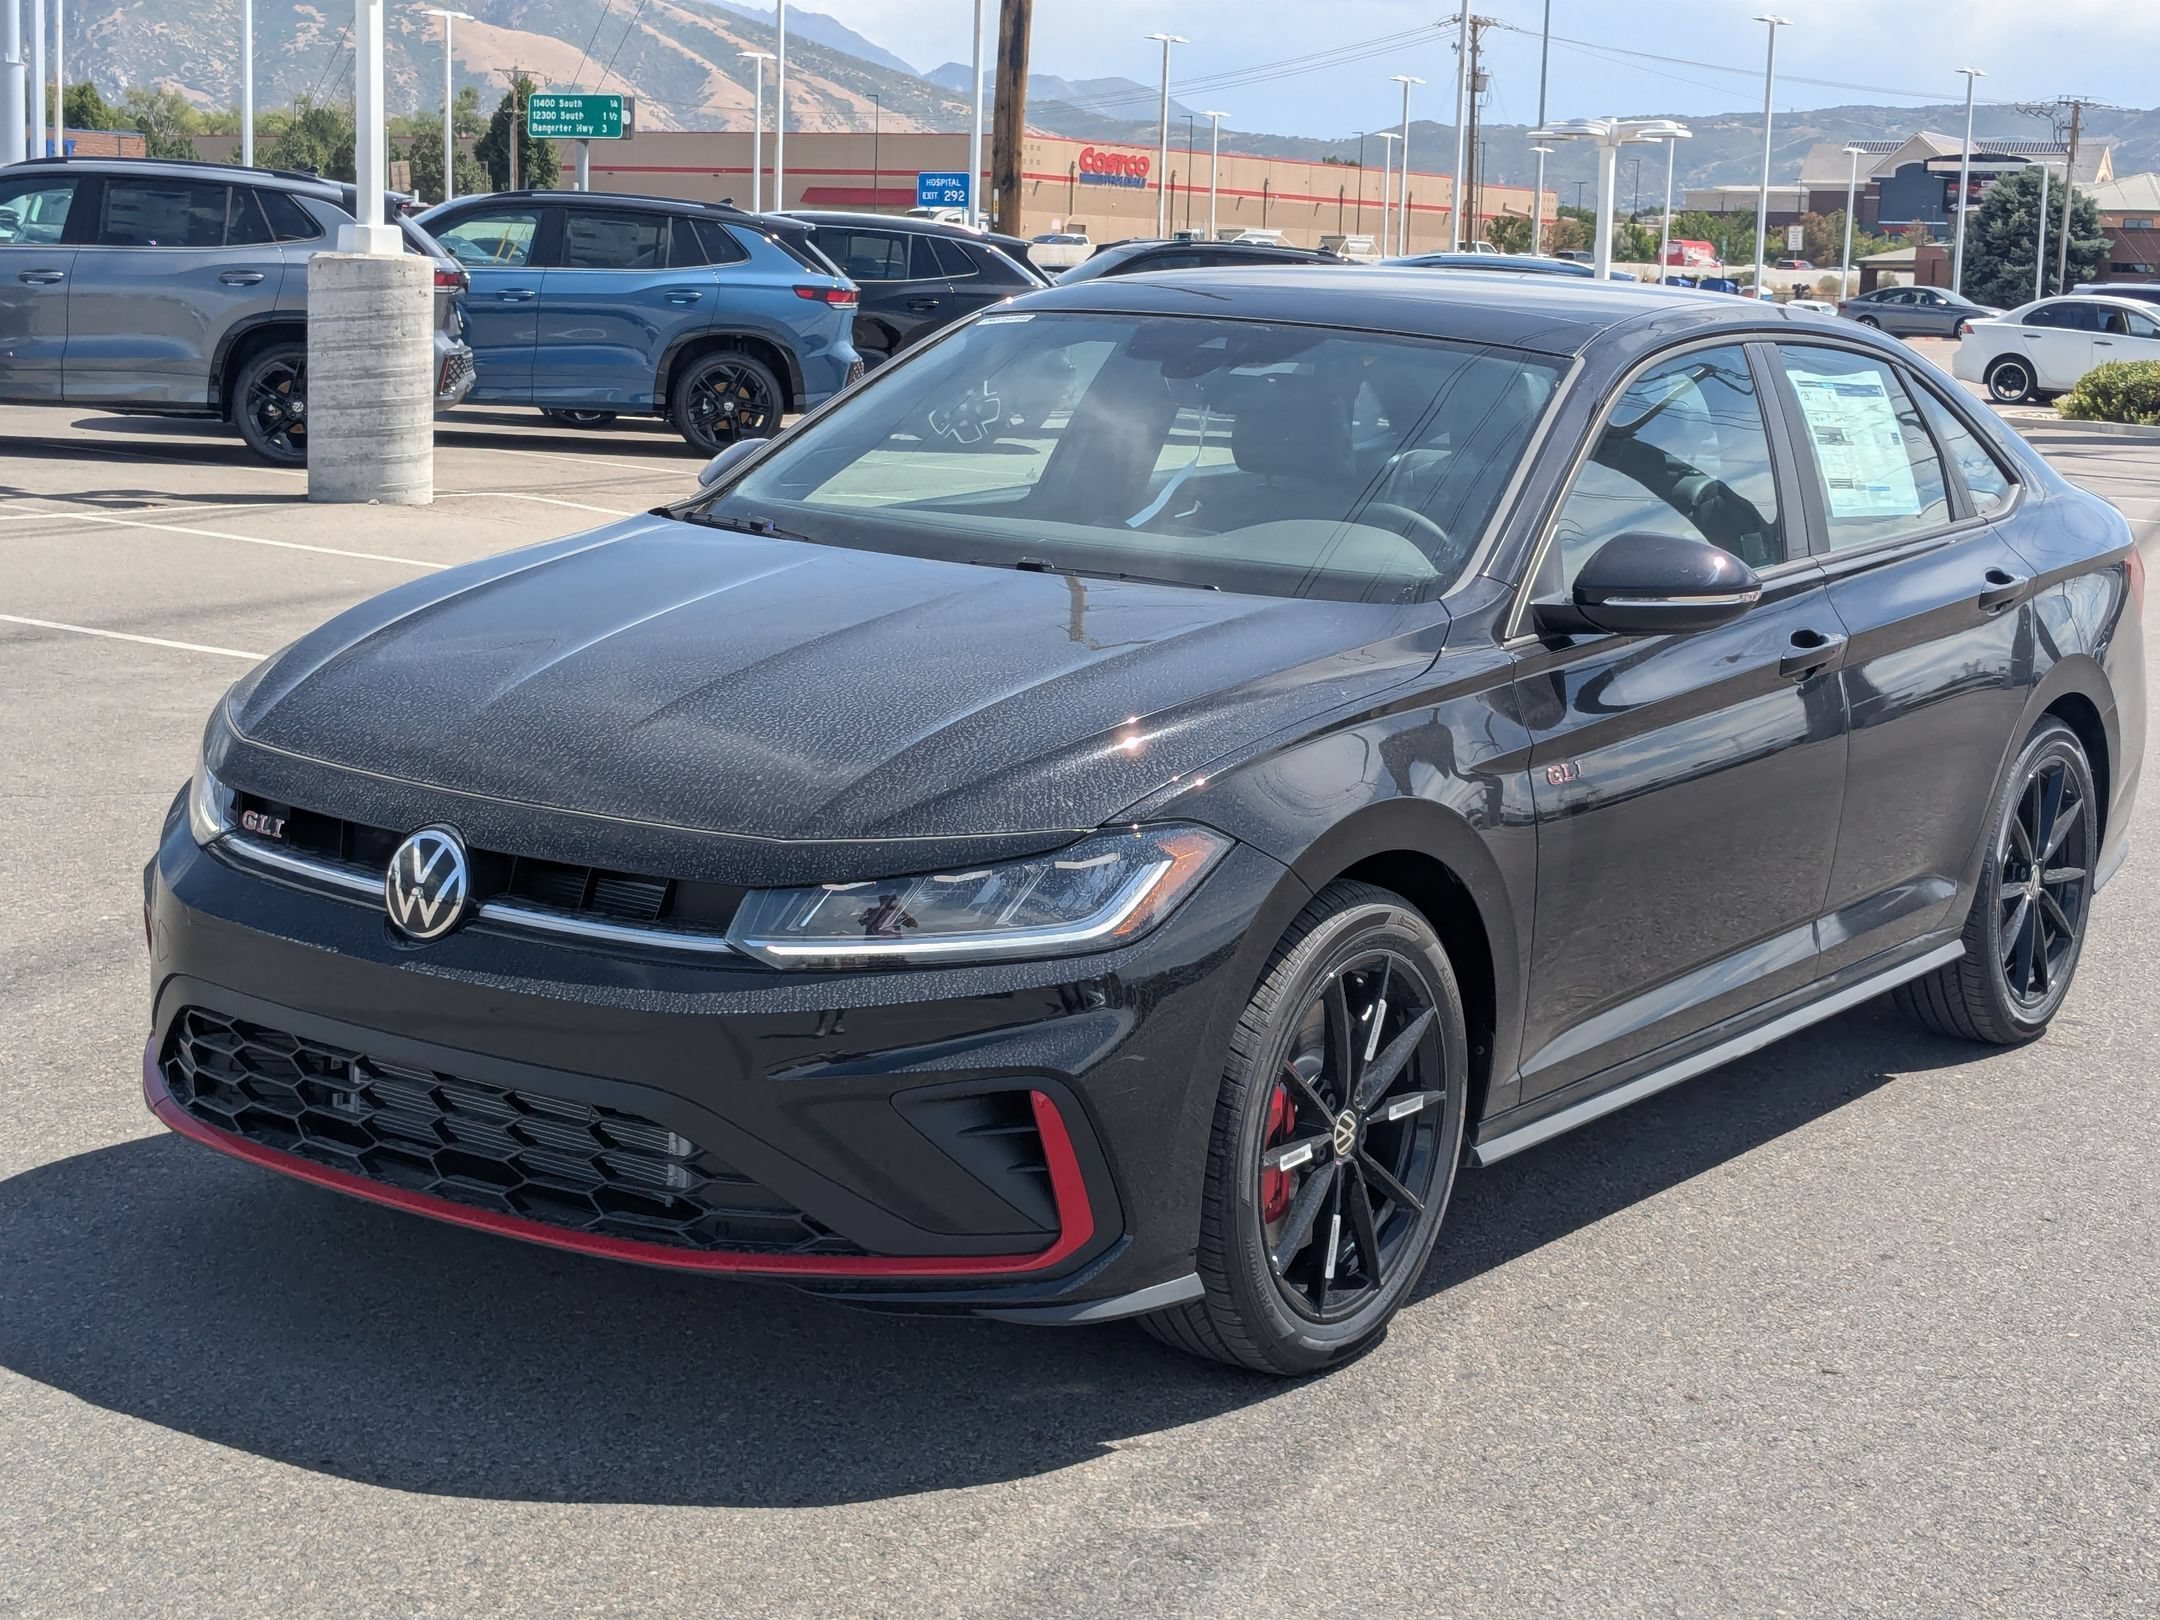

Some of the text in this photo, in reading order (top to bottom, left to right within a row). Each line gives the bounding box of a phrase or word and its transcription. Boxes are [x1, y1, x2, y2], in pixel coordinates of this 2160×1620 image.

[533, 99, 555, 108] 11400
[559, 100, 582, 108] South
[532, 111, 556, 120] 12300
[560, 112, 584, 120] South
[532, 124, 608, 134] Bangerter Hwy 3
[1079, 147, 1150, 178] COSTCO
[926, 179, 962, 187] HOSPITAL
[922, 190, 965, 201] EXIT 292
[1547, 760, 1584, 786] GLI
[242, 810, 286, 839] GLI
